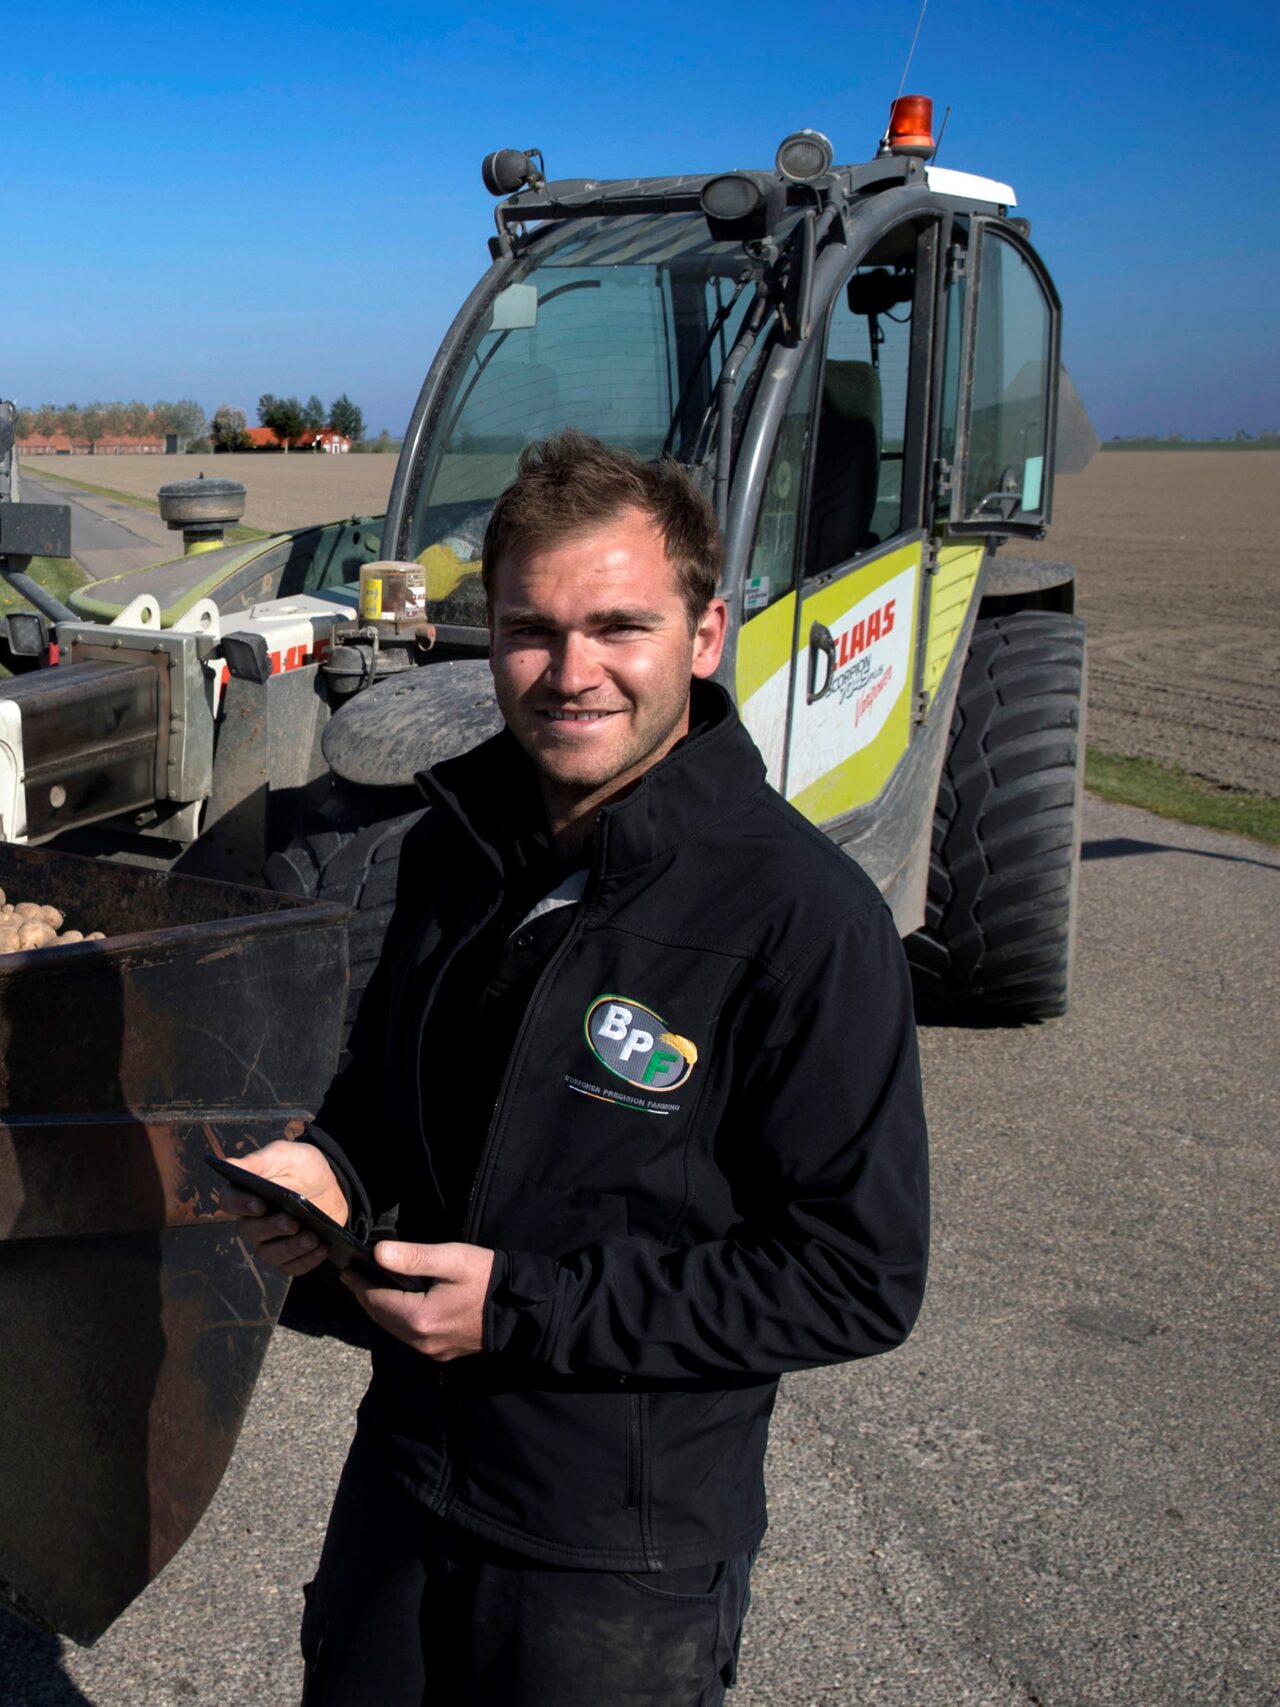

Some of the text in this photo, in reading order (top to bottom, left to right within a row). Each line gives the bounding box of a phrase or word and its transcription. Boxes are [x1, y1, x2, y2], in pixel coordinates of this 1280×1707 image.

[598, 1004, 678, 1083] BPF
[603, 1089, 645, 1107] PRECISION
[647, 1101, 681, 1112] FARMING
